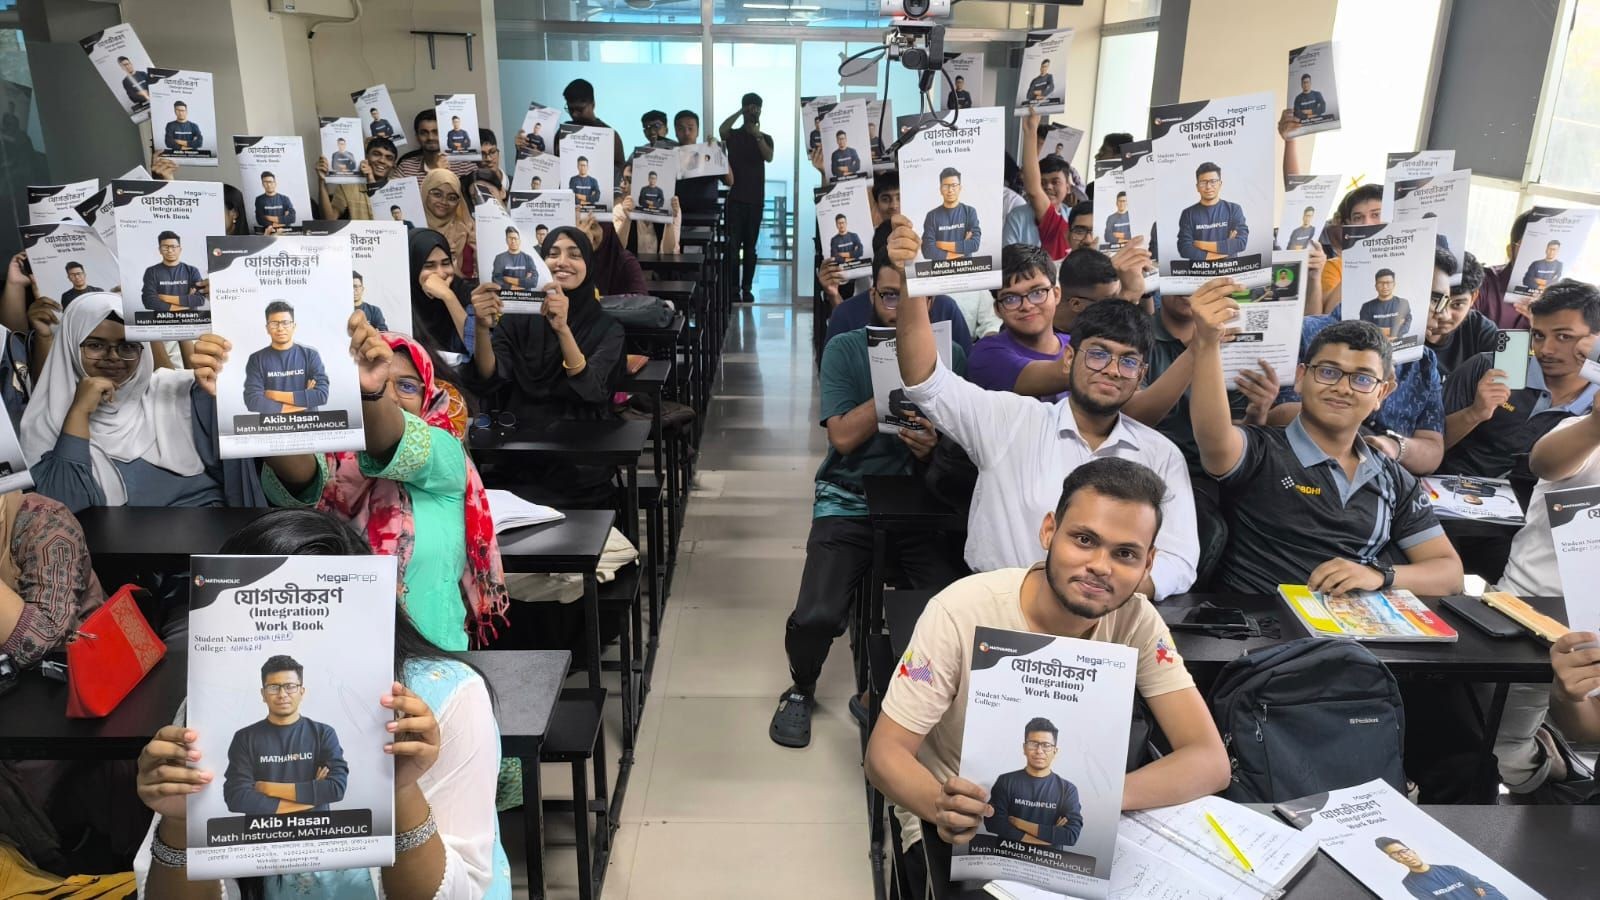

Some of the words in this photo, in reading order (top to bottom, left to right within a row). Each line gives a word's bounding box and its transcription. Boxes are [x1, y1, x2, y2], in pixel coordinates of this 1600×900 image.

[1179, 115, 1245, 134] যোগজীকরণ
[1188, 129, 1236, 141] (Integration)
[1192, 141, 1211, 149] Work
[1213, 139, 1233, 147] Book
[244, 251, 319, 268] যোগজীকরণ
[1212, 260, 1238, 268] Hasan
[255, 269, 310, 277] (Integration)
[259, 278, 282, 286] Work
[285, 277, 307, 285] Book
[263, 415, 287, 424] Akib
[289, 414, 319, 422] Hasan
[236, 425, 256, 433] Math
[258, 423, 295, 432] Instructor,
[297, 421, 347, 429] MATHAHOLIC
[317, 573, 377, 584] MegaPrep
[234, 582, 344, 605] যোগজীকরণ
[249, 606, 330, 619] (Integration)
[255, 621, 288, 631] Work
[292, 620, 324, 631] Book
[194, 635, 224, 643] Student
[226, 634, 254, 643] Name:
[194, 644, 227, 653] College:
[1076, 654, 1126, 669] MegaPrep
[1011, 658, 1097, 682] যোগজীকরণ
[1021, 674, 1085, 692] (Integration)
[975, 690, 1000, 700] Student
[1025, 686, 1050, 698] Work
[1053, 691, 1079, 703] Book
[260, 752, 313, 763] MATHAHOLIC
[1320, 799, 1381, 821] যোগজীকরণ
[249, 817, 283, 830] Akib
[287, 815, 330, 828] Hasan
[211, 833, 239, 843] Math
[241, 829, 295, 842] Instructor,
[297, 825, 368, 838] MATHAHOLIC
[1000, 839, 1026, 852] Akib
[1028, 845, 1062, 860] Hasan
[993, 848, 1034, 862] Instructor,
[1035, 856, 1092, 874] MATHAHOLIC
